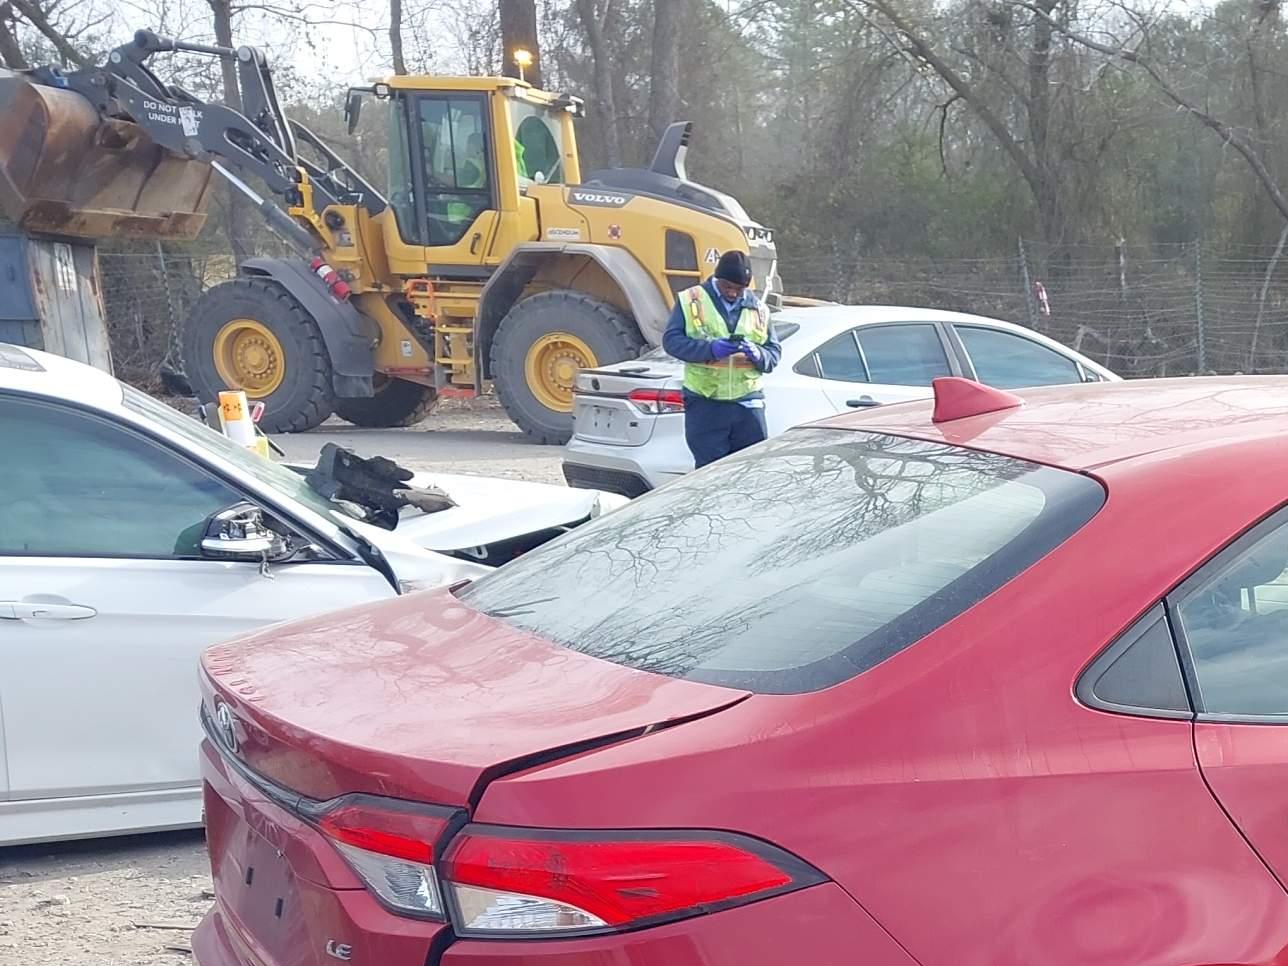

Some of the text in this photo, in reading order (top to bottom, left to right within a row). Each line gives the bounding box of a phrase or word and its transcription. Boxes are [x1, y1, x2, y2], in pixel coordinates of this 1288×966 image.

[143, 101, 157, 110] DO
[158, 104, 177, 113] NOT
[148, 112, 177, 124] UNDER
[573, 192, 626, 204] VOLVO
[326, 939, 353, 960] LE
